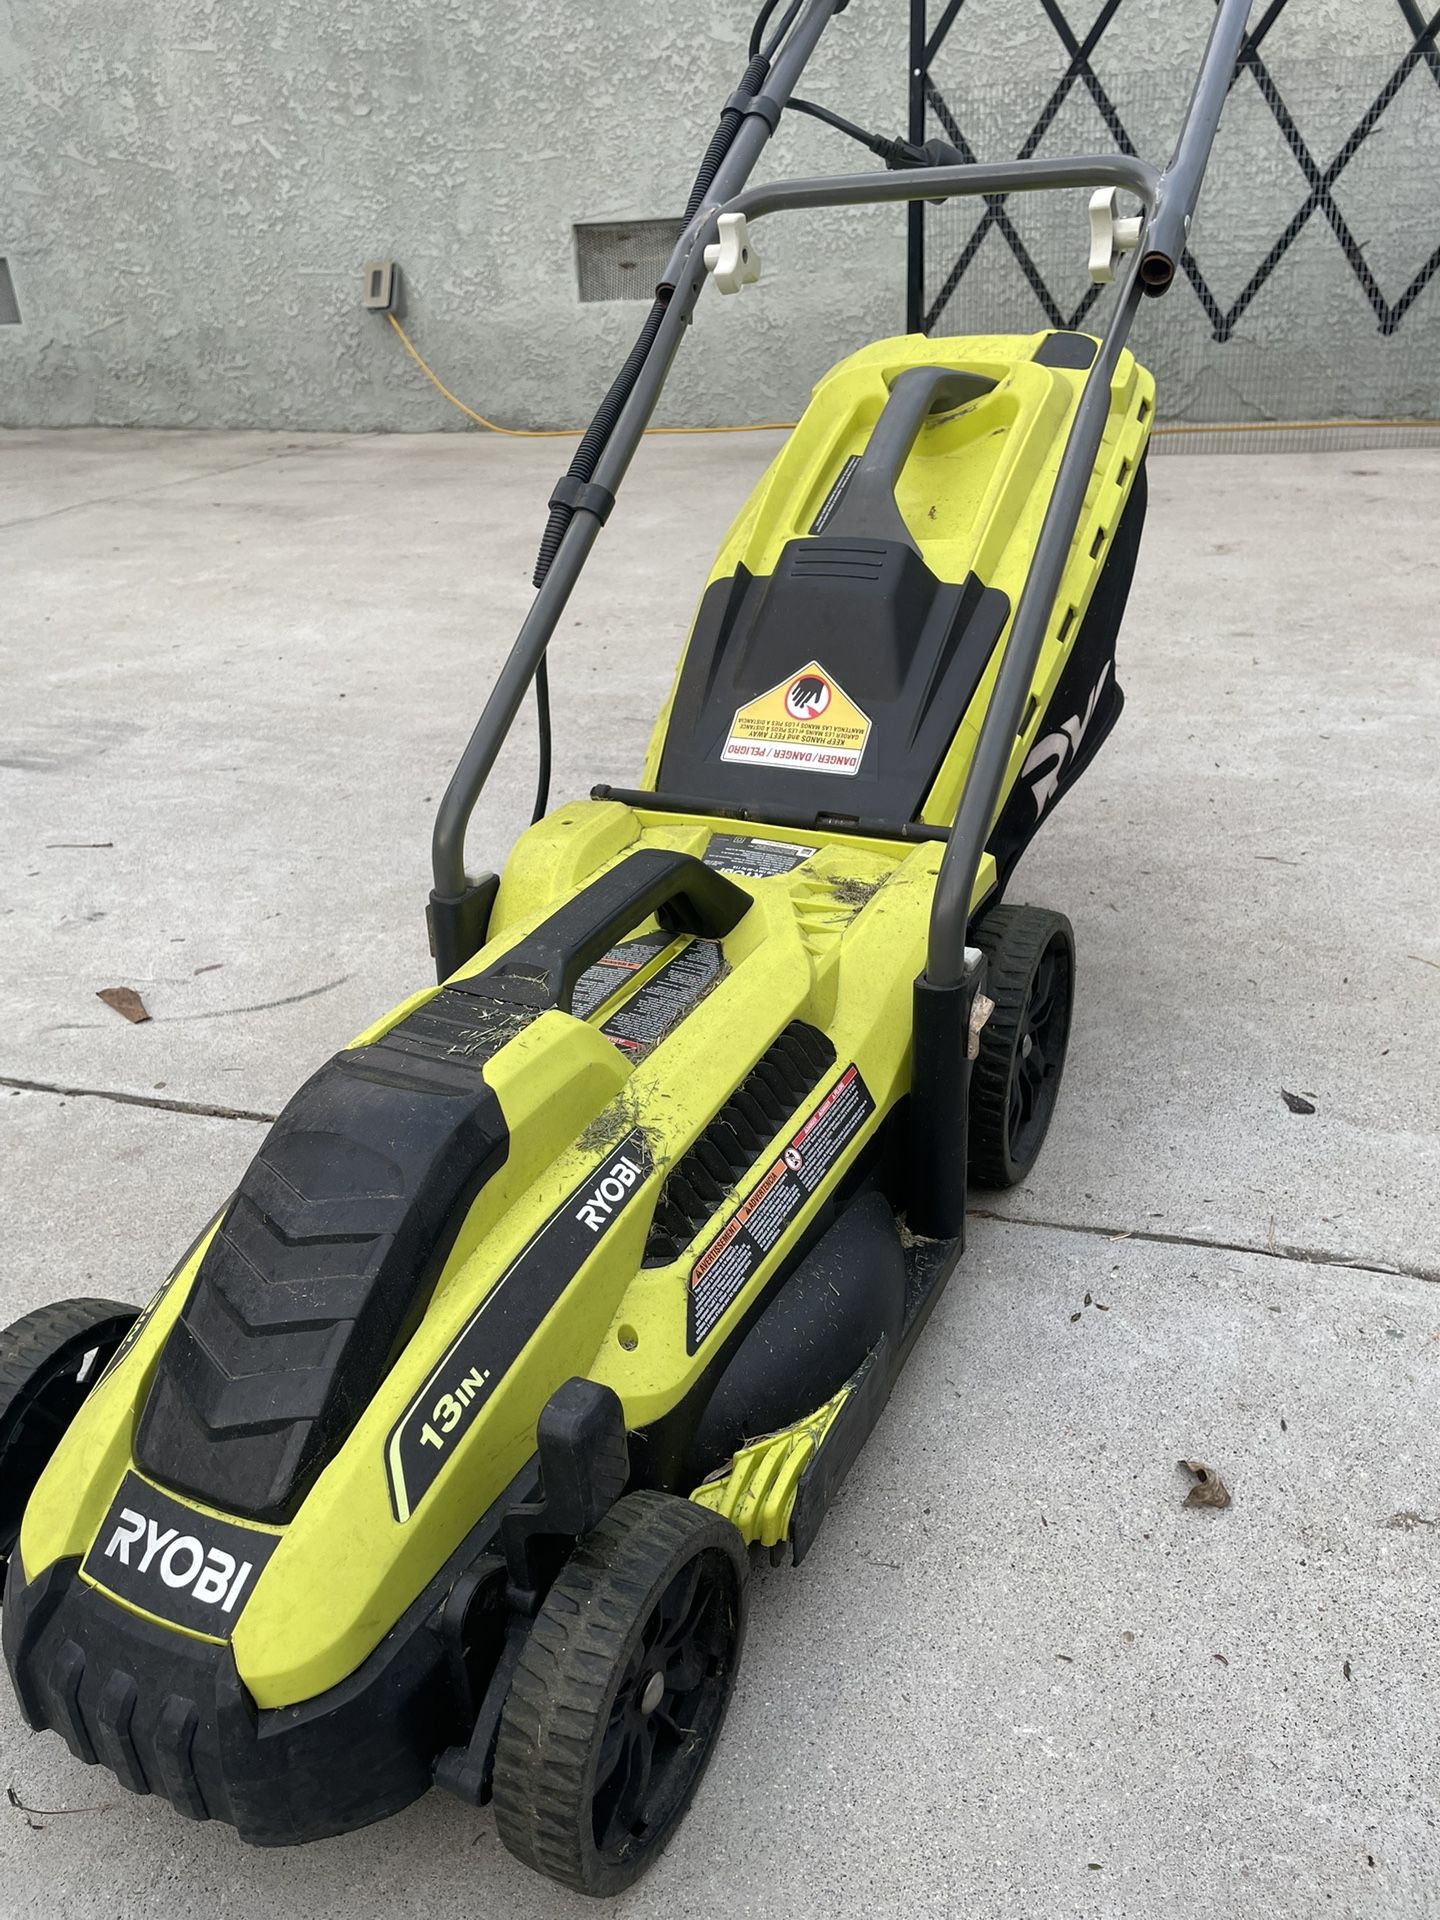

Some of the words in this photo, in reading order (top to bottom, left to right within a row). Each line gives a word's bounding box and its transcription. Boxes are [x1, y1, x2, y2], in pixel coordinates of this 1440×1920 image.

[748, 730, 769, 738] AWAY
[769, 732, 786, 740] FEET
[801, 735, 826, 744] HANDS
[827, 738, 845, 746] KEEP
[728, 744, 766, 757] PELIGRO
[773, 749, 812, 761] DANGER
[818, 754, 857, 766] DANGER
[575, 1155, 642, 1232] RYOBI
[749, 1172, 778, 1209] ADVERTENCIA
[701, 1223, 738, 1274] AVERTISSEMENT
[104, 1507, 254, 1614] RYOBI
